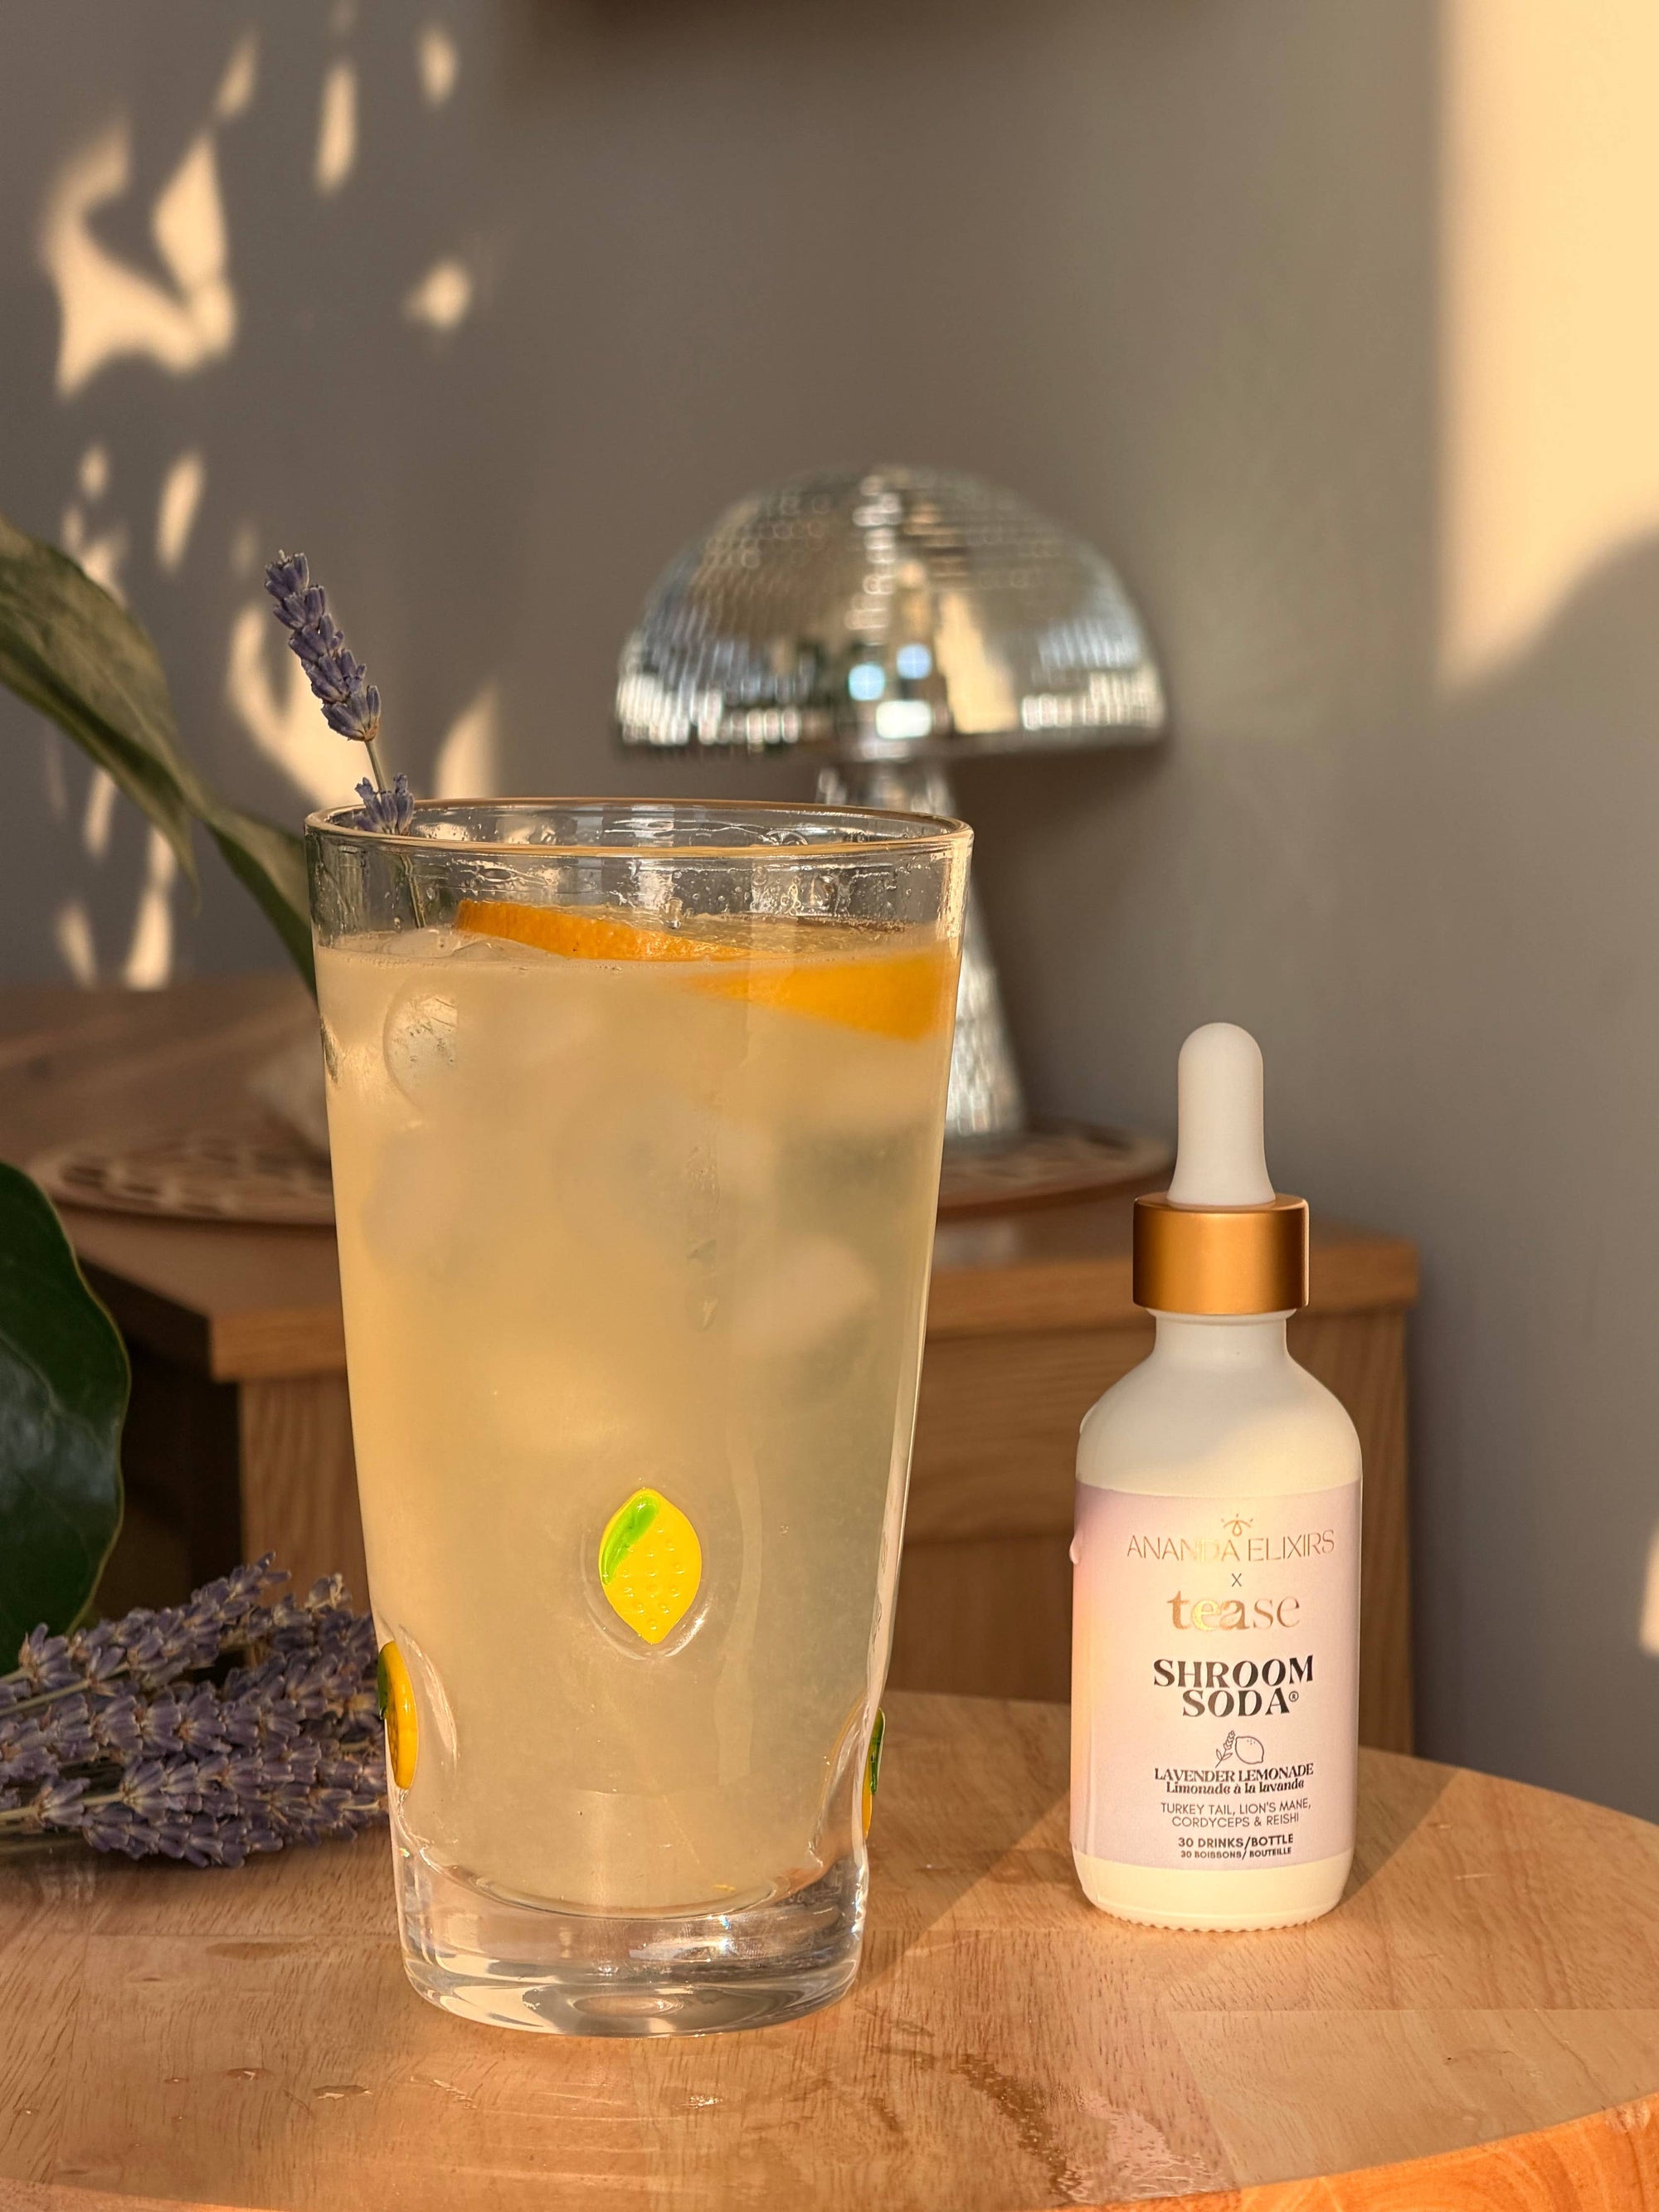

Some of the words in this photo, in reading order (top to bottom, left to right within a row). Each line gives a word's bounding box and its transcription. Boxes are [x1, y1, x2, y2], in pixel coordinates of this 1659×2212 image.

[1126, 1534, 1240, 1562] ANANDA
[1248, 1529, 1335, 1562] ELIXIRS
[1167, 1590, 1301, 1631] tease
[1153, 1655, 1314, 1689] SHROOM
[1154, 1767, 1235, 1782] LAVENDER
[1238, 1762, 1315, 1782] LEMONADE
[1166, 1781, 1231, 1795] Limonade
[1233, 1782, 1242, 1794] à
[1244, 1782, 1256, 1794] la
[1259, 1777, 1305, 1793] lavande
[1160, 1802, 1204, 1815] TURKEY
[1208, 1804, 1236, 1816] TAIL,
[1239, 1802, 1277, 1815] LION'S
[1278, 1797, 1311, 1813] MANE,
[1171, 1816, 1250, 1829] CORDYCEPS
[1253, 1816, 1262, 1826] &
[1266, 1813, 1299, 1826] REISHI
[1178, 1836, 1194, 1848] 30
[1180, 1850, 1192, 1859] 30
